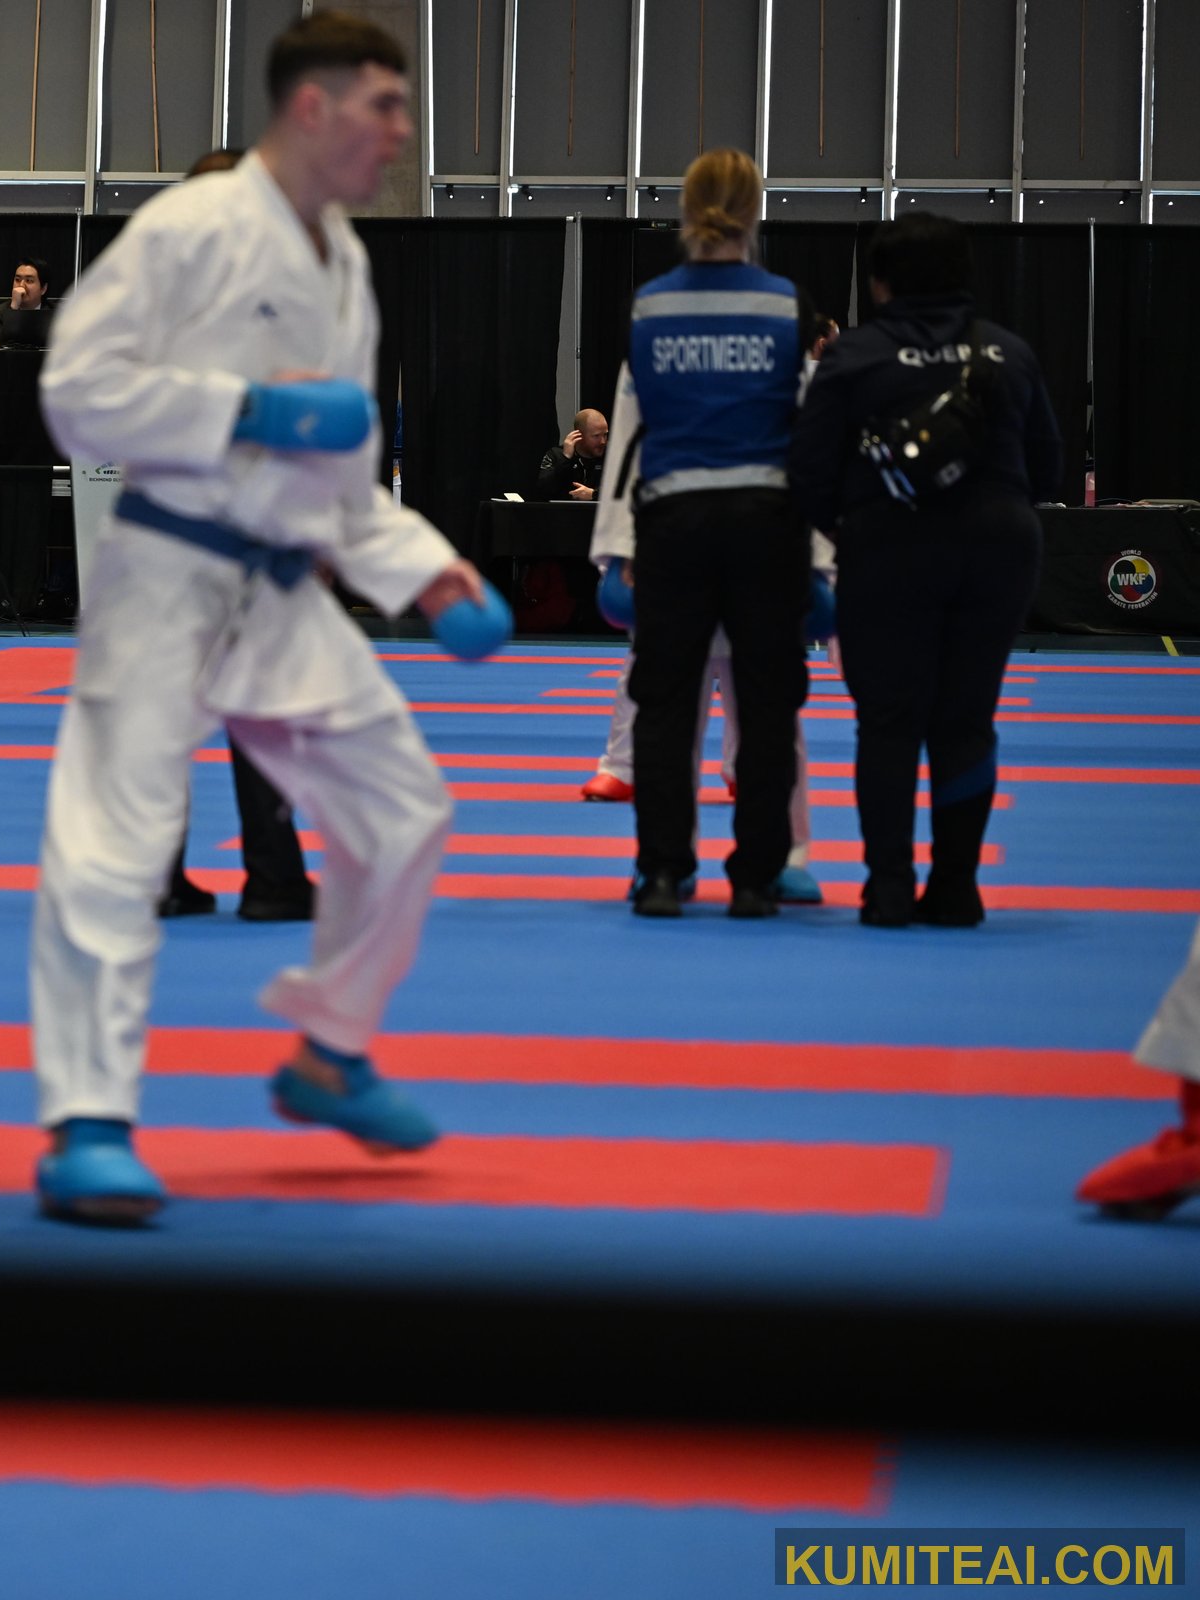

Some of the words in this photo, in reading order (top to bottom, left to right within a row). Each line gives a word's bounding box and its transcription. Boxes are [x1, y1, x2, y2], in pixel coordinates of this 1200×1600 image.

[652, 335, 775, 373] SPORTMEDBC
[897, 344, 1005, 368] QUEBC
[1117, 573, 1145, 586] WKF
[1107, 593, 1126, 608] KARATE
[1127, 591, 1158, 609] FEDERATION
